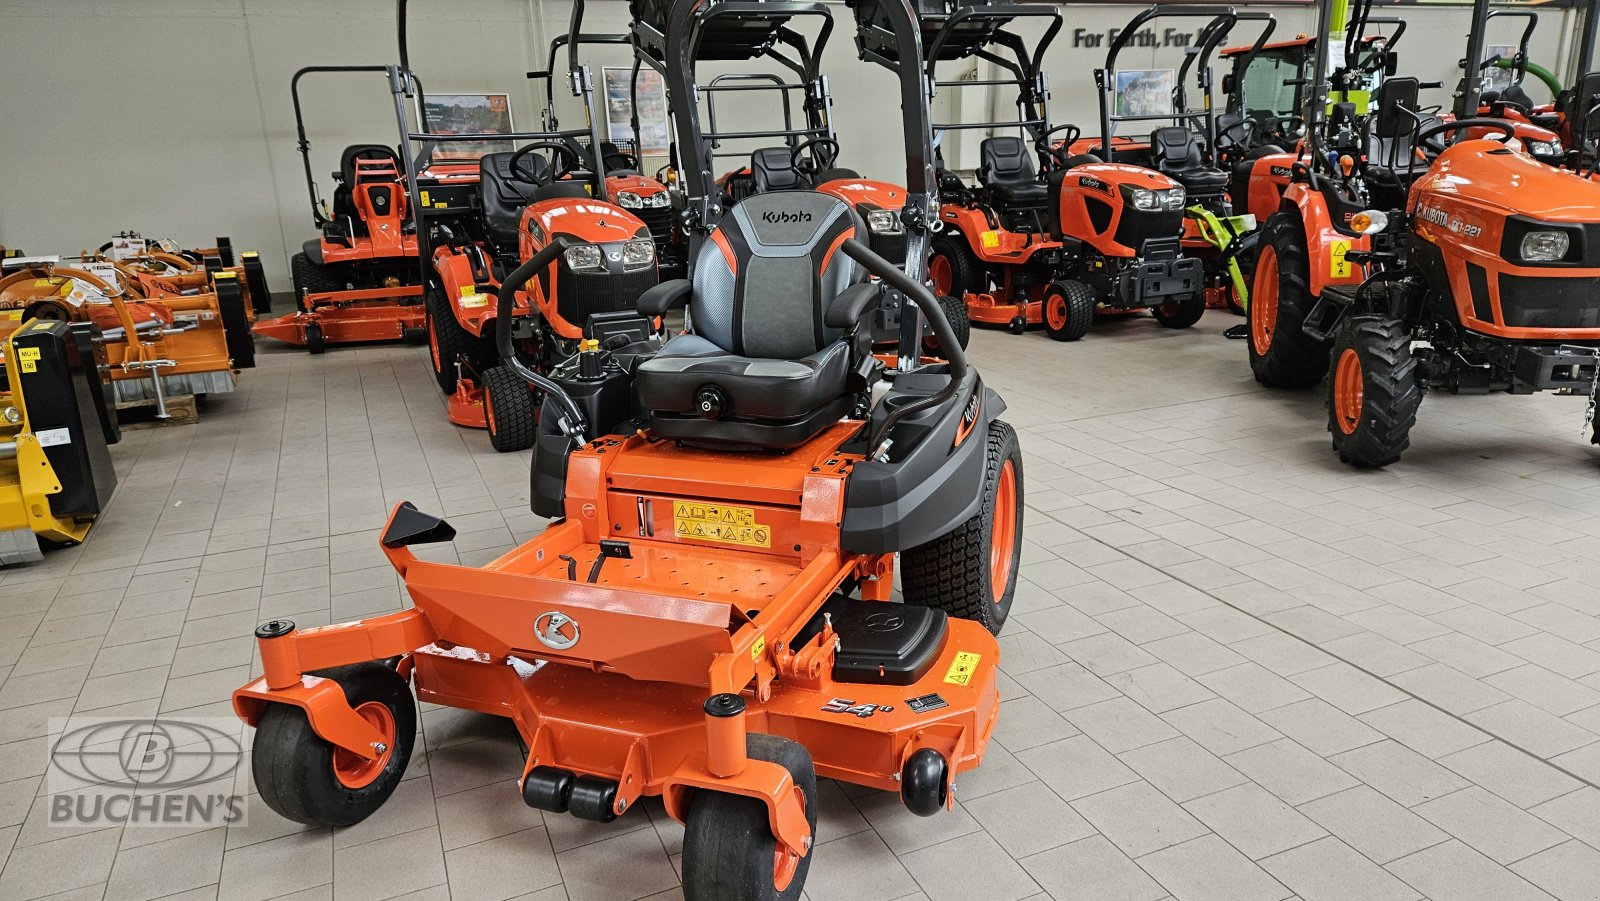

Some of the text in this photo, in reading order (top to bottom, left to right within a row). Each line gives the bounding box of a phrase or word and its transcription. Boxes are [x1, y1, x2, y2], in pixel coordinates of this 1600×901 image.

[1073, 28, 1104, 48] For
[1108, 27, 1161, 49] Erth,
[1164, 27, 1193, 47] For
[762, 210, 812, 223] Kubota
[1422, 206, 1448, 227] KUBOTA
